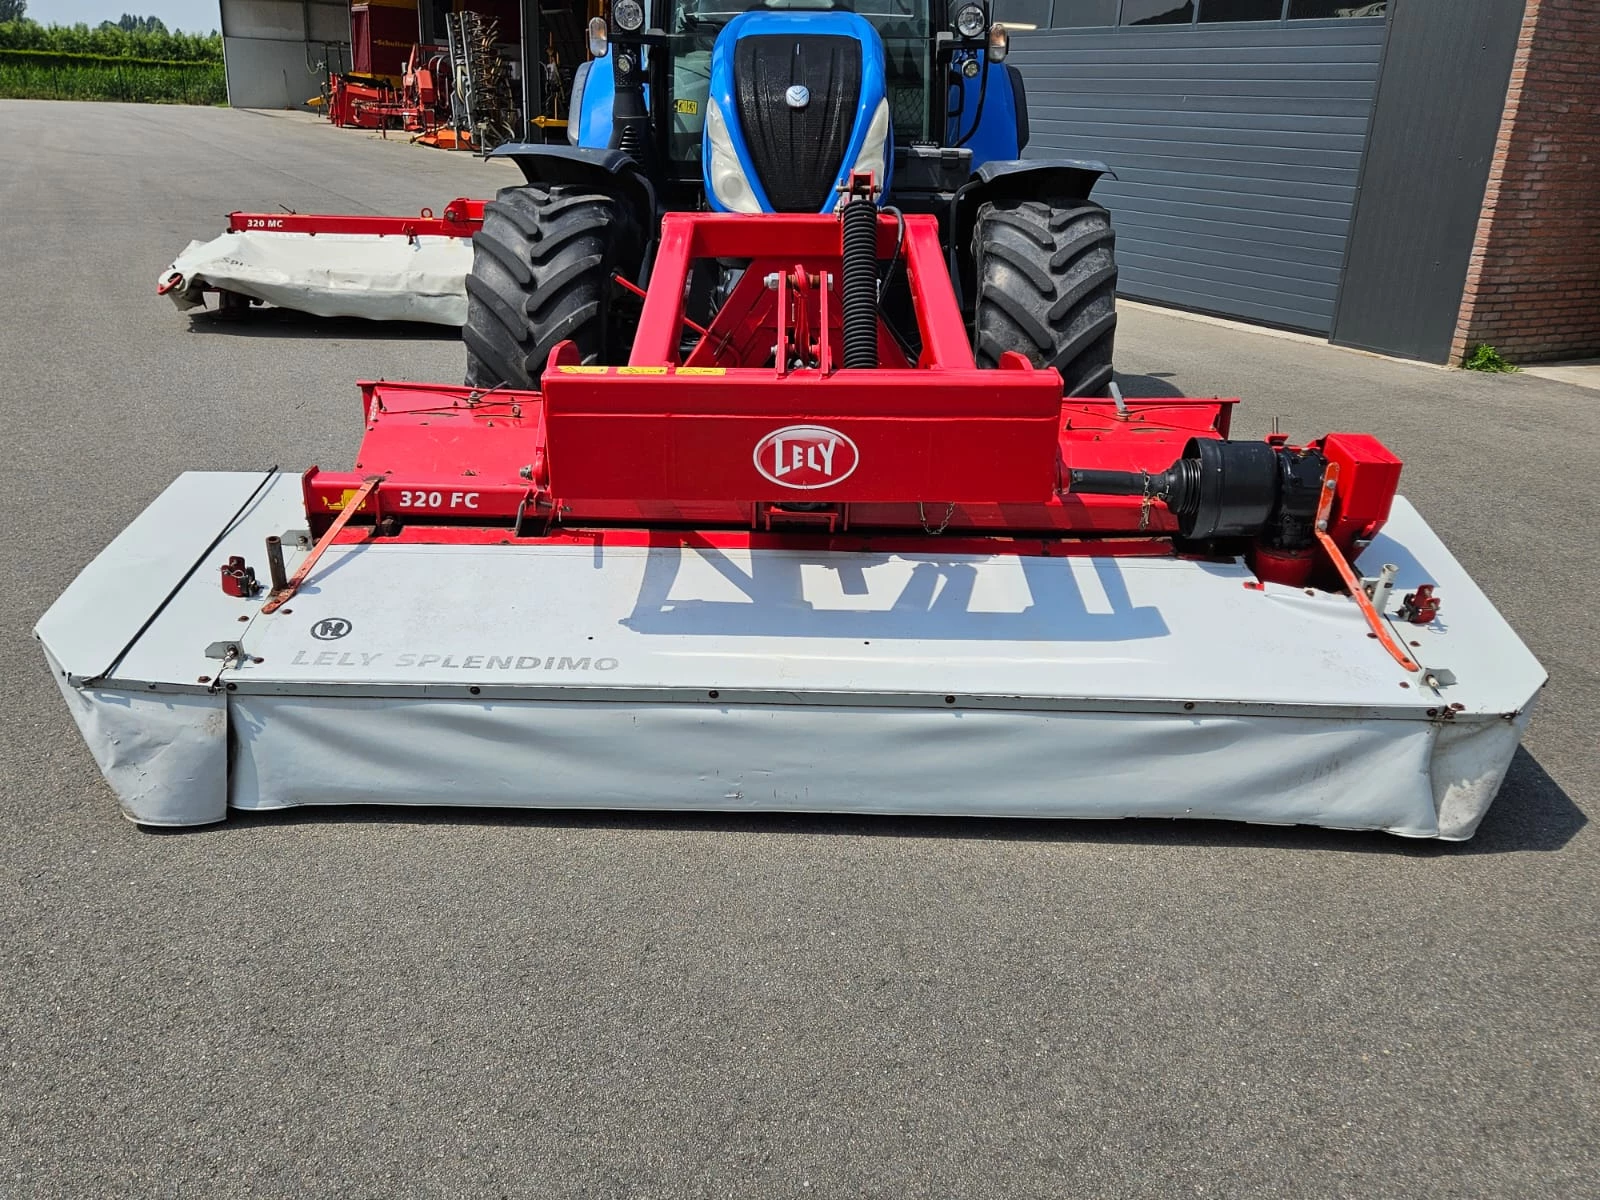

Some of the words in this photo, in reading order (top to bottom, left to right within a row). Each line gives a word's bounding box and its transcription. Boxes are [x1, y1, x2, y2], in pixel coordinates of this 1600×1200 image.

[247, 219, 265, 228] 320
[267, 219, 284, 228] MC
[775, 438, 837, 477] LELY
[400, 491, 442, 507] 320
[450, 492, 480, 508] FC
[290, 650, 382, 667] LELY
[394, 653, 619, 672] SPLENDIMO
